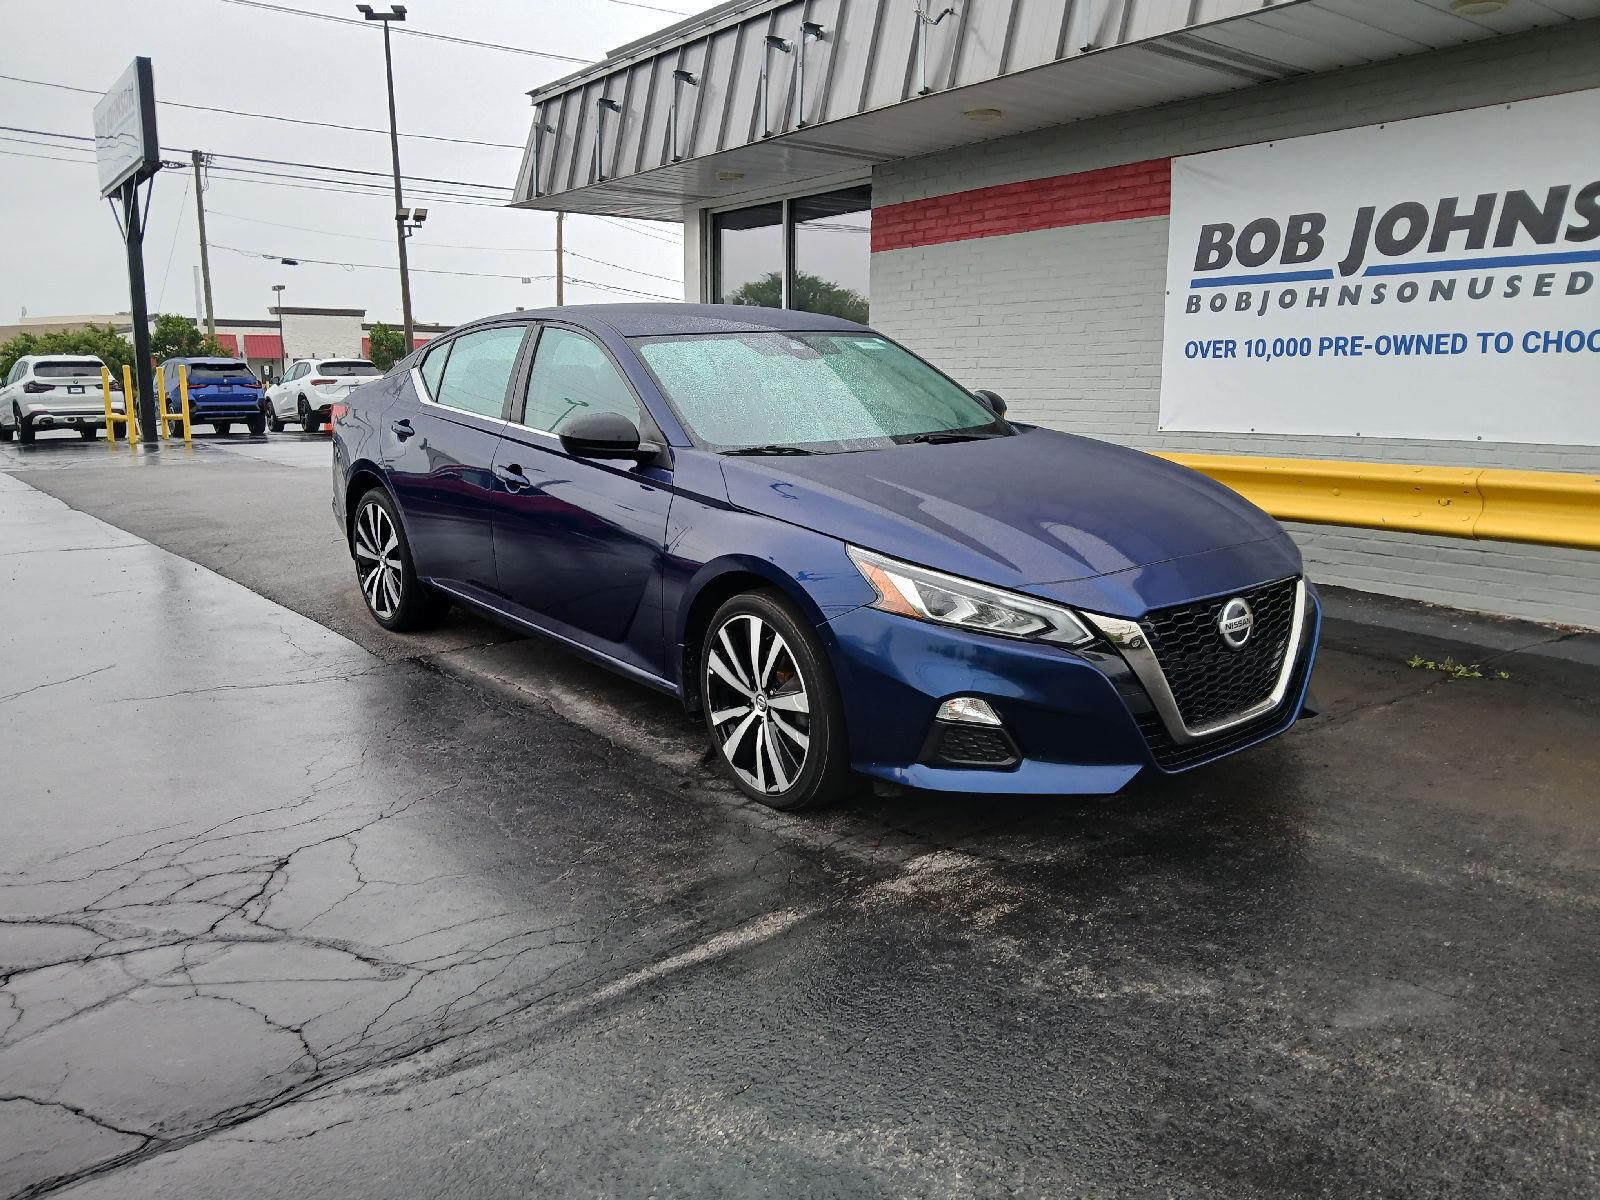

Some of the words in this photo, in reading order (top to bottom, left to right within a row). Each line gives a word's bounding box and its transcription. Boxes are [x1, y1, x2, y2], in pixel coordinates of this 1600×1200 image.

[1193, 212, 1327, 272] BOB
[1338, 180, 1600, 277] JOHNS
[1185, 270, 1594, 316] BOBJOHNSONUSED
[1184, 340, 1237, 360] OVER
[1244, 337, 1312, 362] 10,000
[1318, 333, 1468, 357] PRE-OWNED
[1476, 331, 1514, 354] TO
[1522, 329, 1600, 353] CHOO
[1225, 618, 1250, 630] NISSAN
